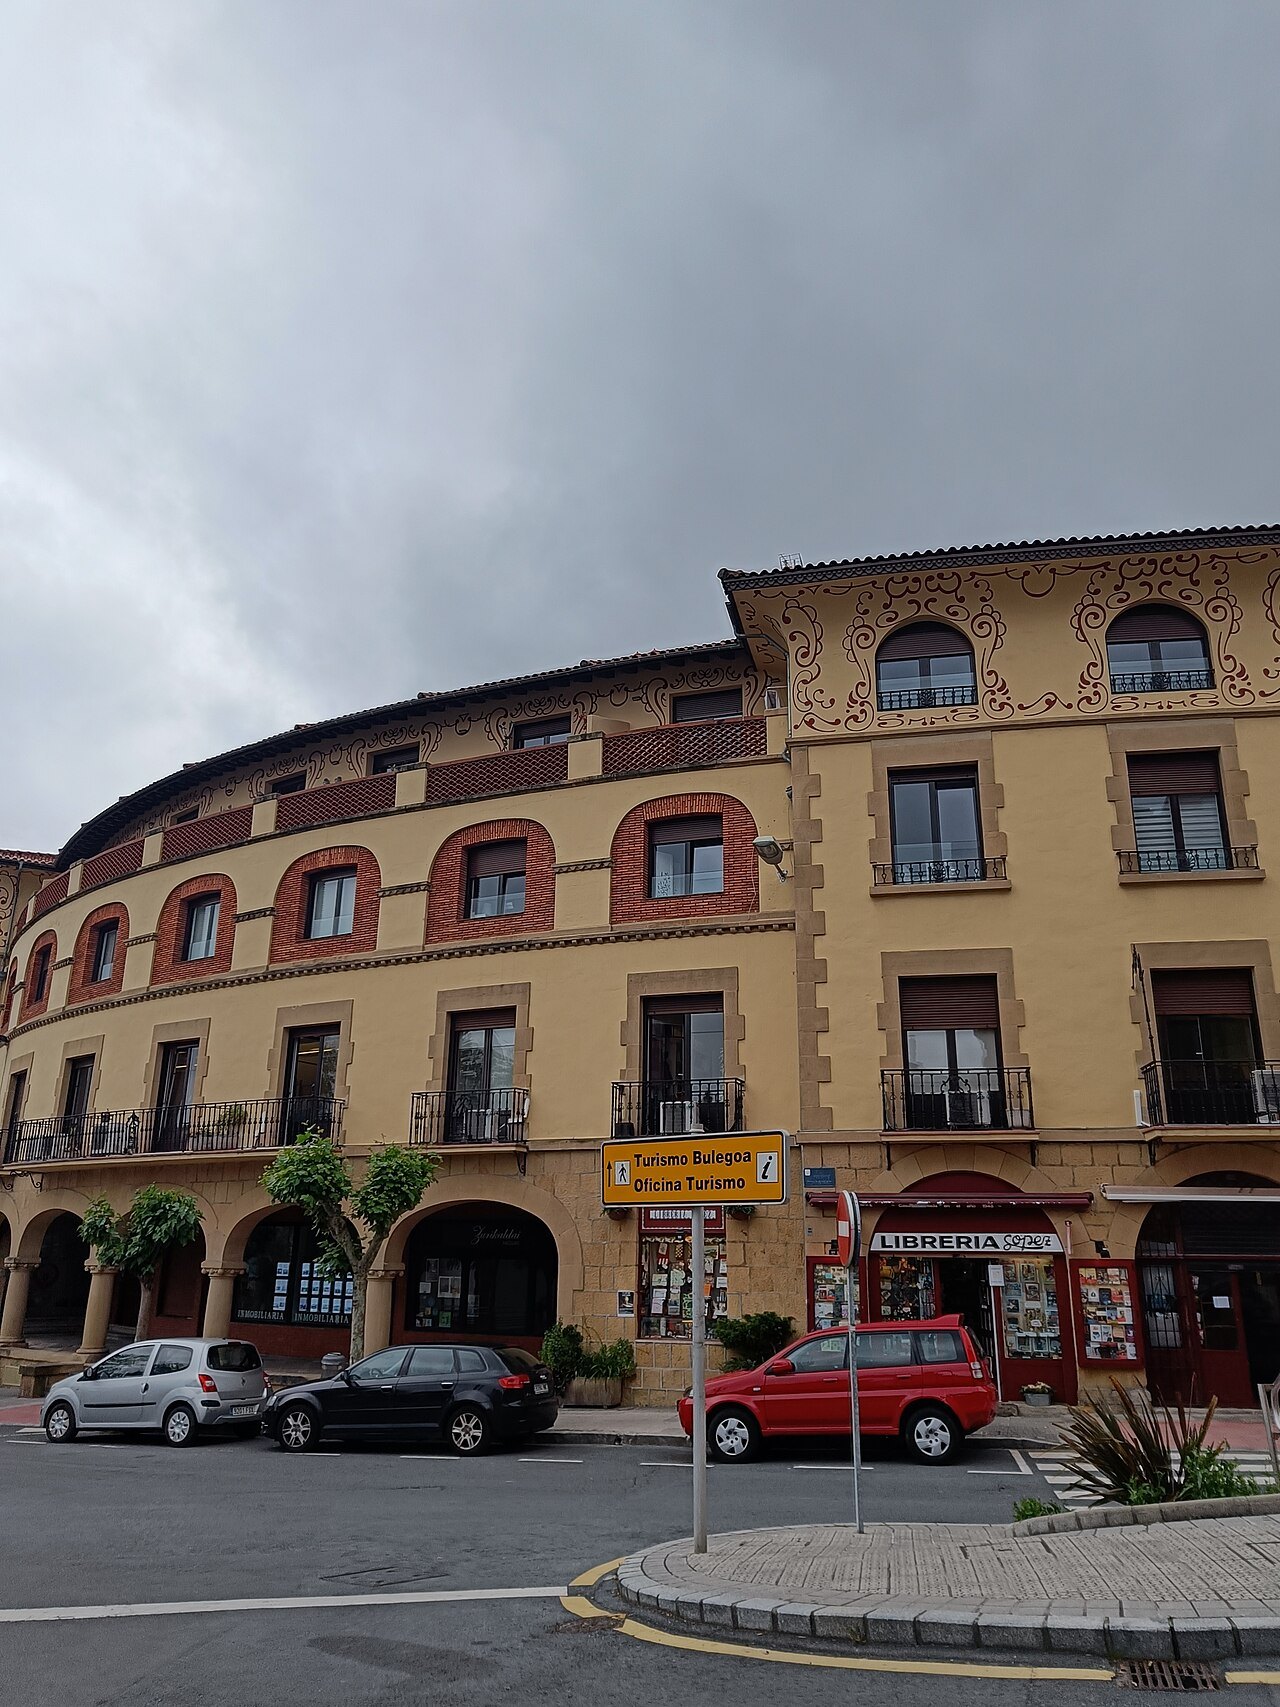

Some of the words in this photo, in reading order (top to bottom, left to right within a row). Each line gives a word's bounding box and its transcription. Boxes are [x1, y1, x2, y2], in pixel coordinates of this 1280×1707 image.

[634, 1153, 688, 1167] Turismo
[693, 1150, 751, 1166] Bulegoa
[634, 1177, 682, 1192] Oficina
[686, 1176, 745, 1191] Turismo
[880, 1235, 1000, 1250] LIBRERIA
[237, 1309, 284, 1320] INMOBILIARIA
[294, 1312, 349, 1323] INMOBILIARIA
